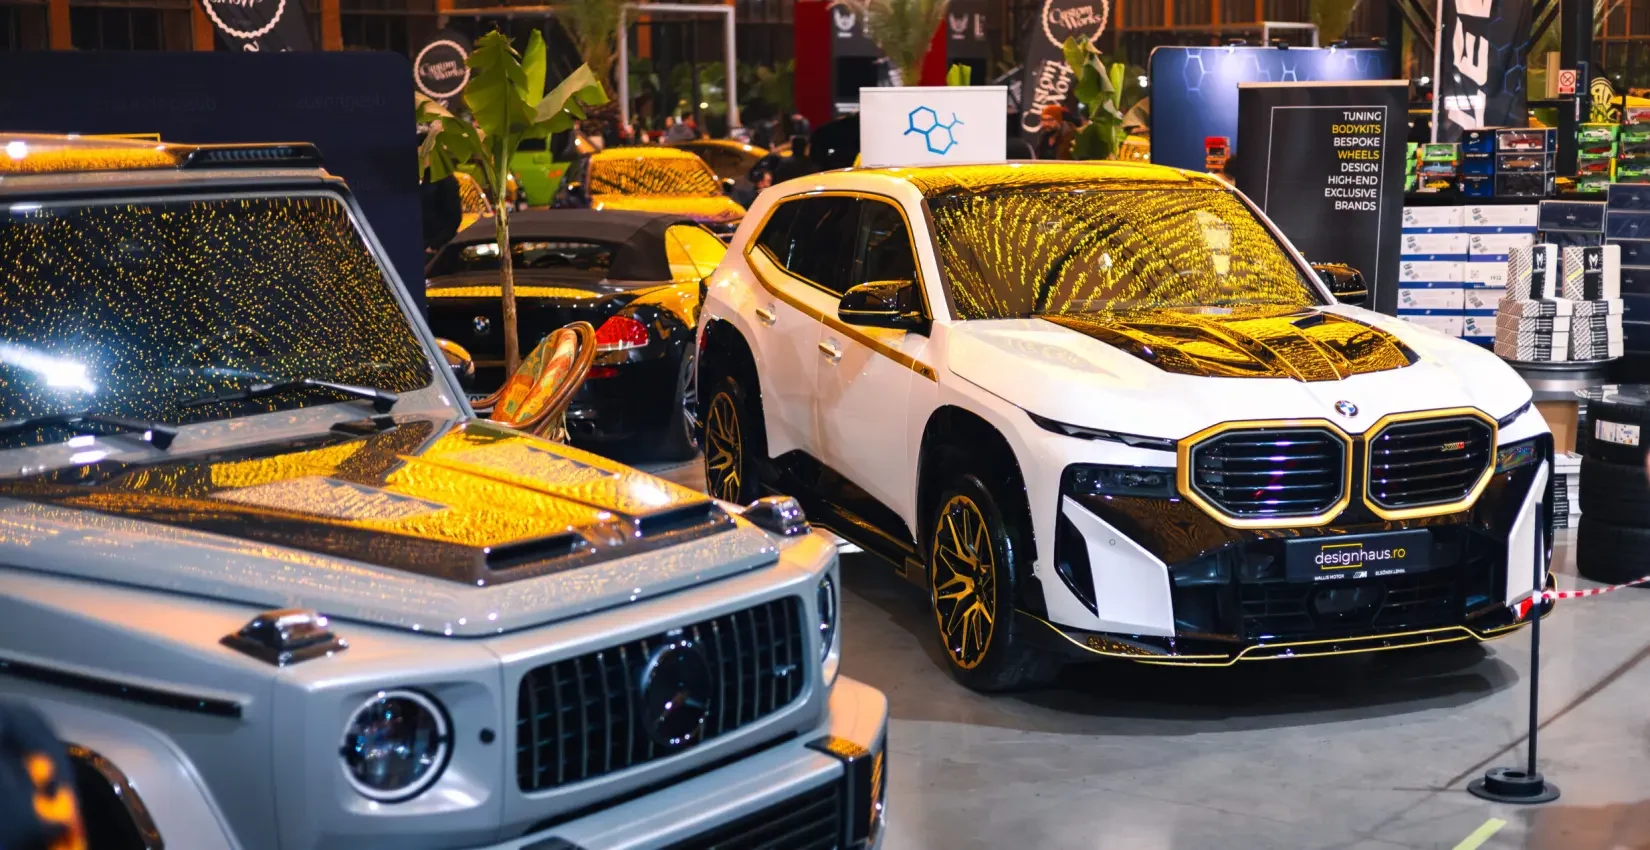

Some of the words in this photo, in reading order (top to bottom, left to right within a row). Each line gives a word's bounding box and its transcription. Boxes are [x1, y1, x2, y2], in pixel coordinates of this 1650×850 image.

[1343, 111, 1381, 121] TUNING
[1332, 124, 1381, 134] BODYKITS
[1333, 137, 1380, 147] BESPOKE
[1337, 150, 1380, 159] WHEELS
[1341, 163, 1379, 172] DESIGN
[1328, 175, 1378, 185] HIGH-END
[1324, 188, 1377, 198] EXCLUSIVE
[1335, 201, 1376, 210] BRANDS
[1315, 548, 1405, 565] designhaus.ro
